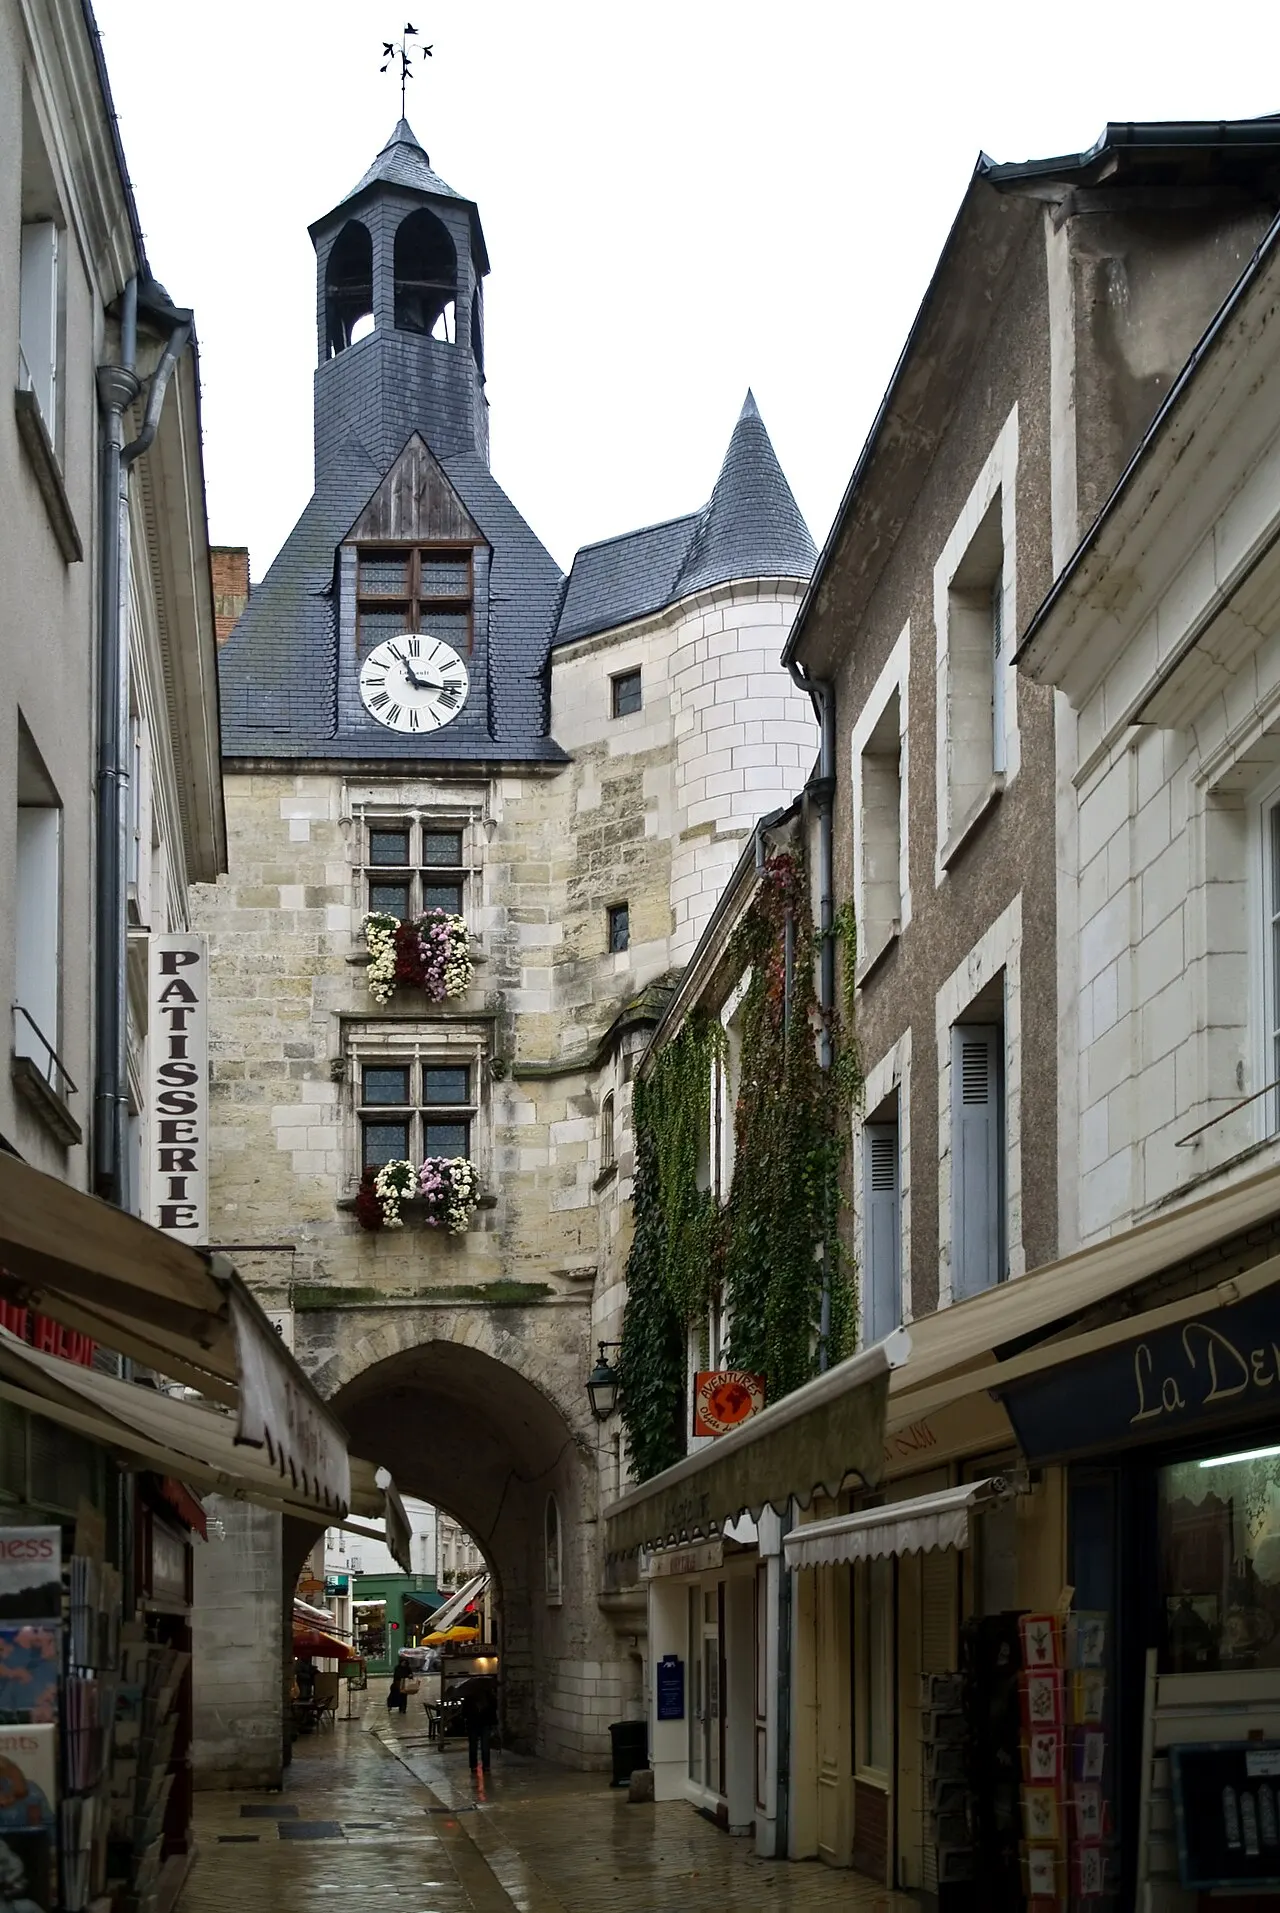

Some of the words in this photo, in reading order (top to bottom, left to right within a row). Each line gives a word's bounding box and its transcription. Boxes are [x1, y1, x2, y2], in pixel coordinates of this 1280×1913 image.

[156, 951, 200, 1229] PATISSERIE
[701, 1373, 761, 1399] AVENTURES
[1129, 1344, 1186, 1424] La
[1182, 1322, 1280, 1404] De
